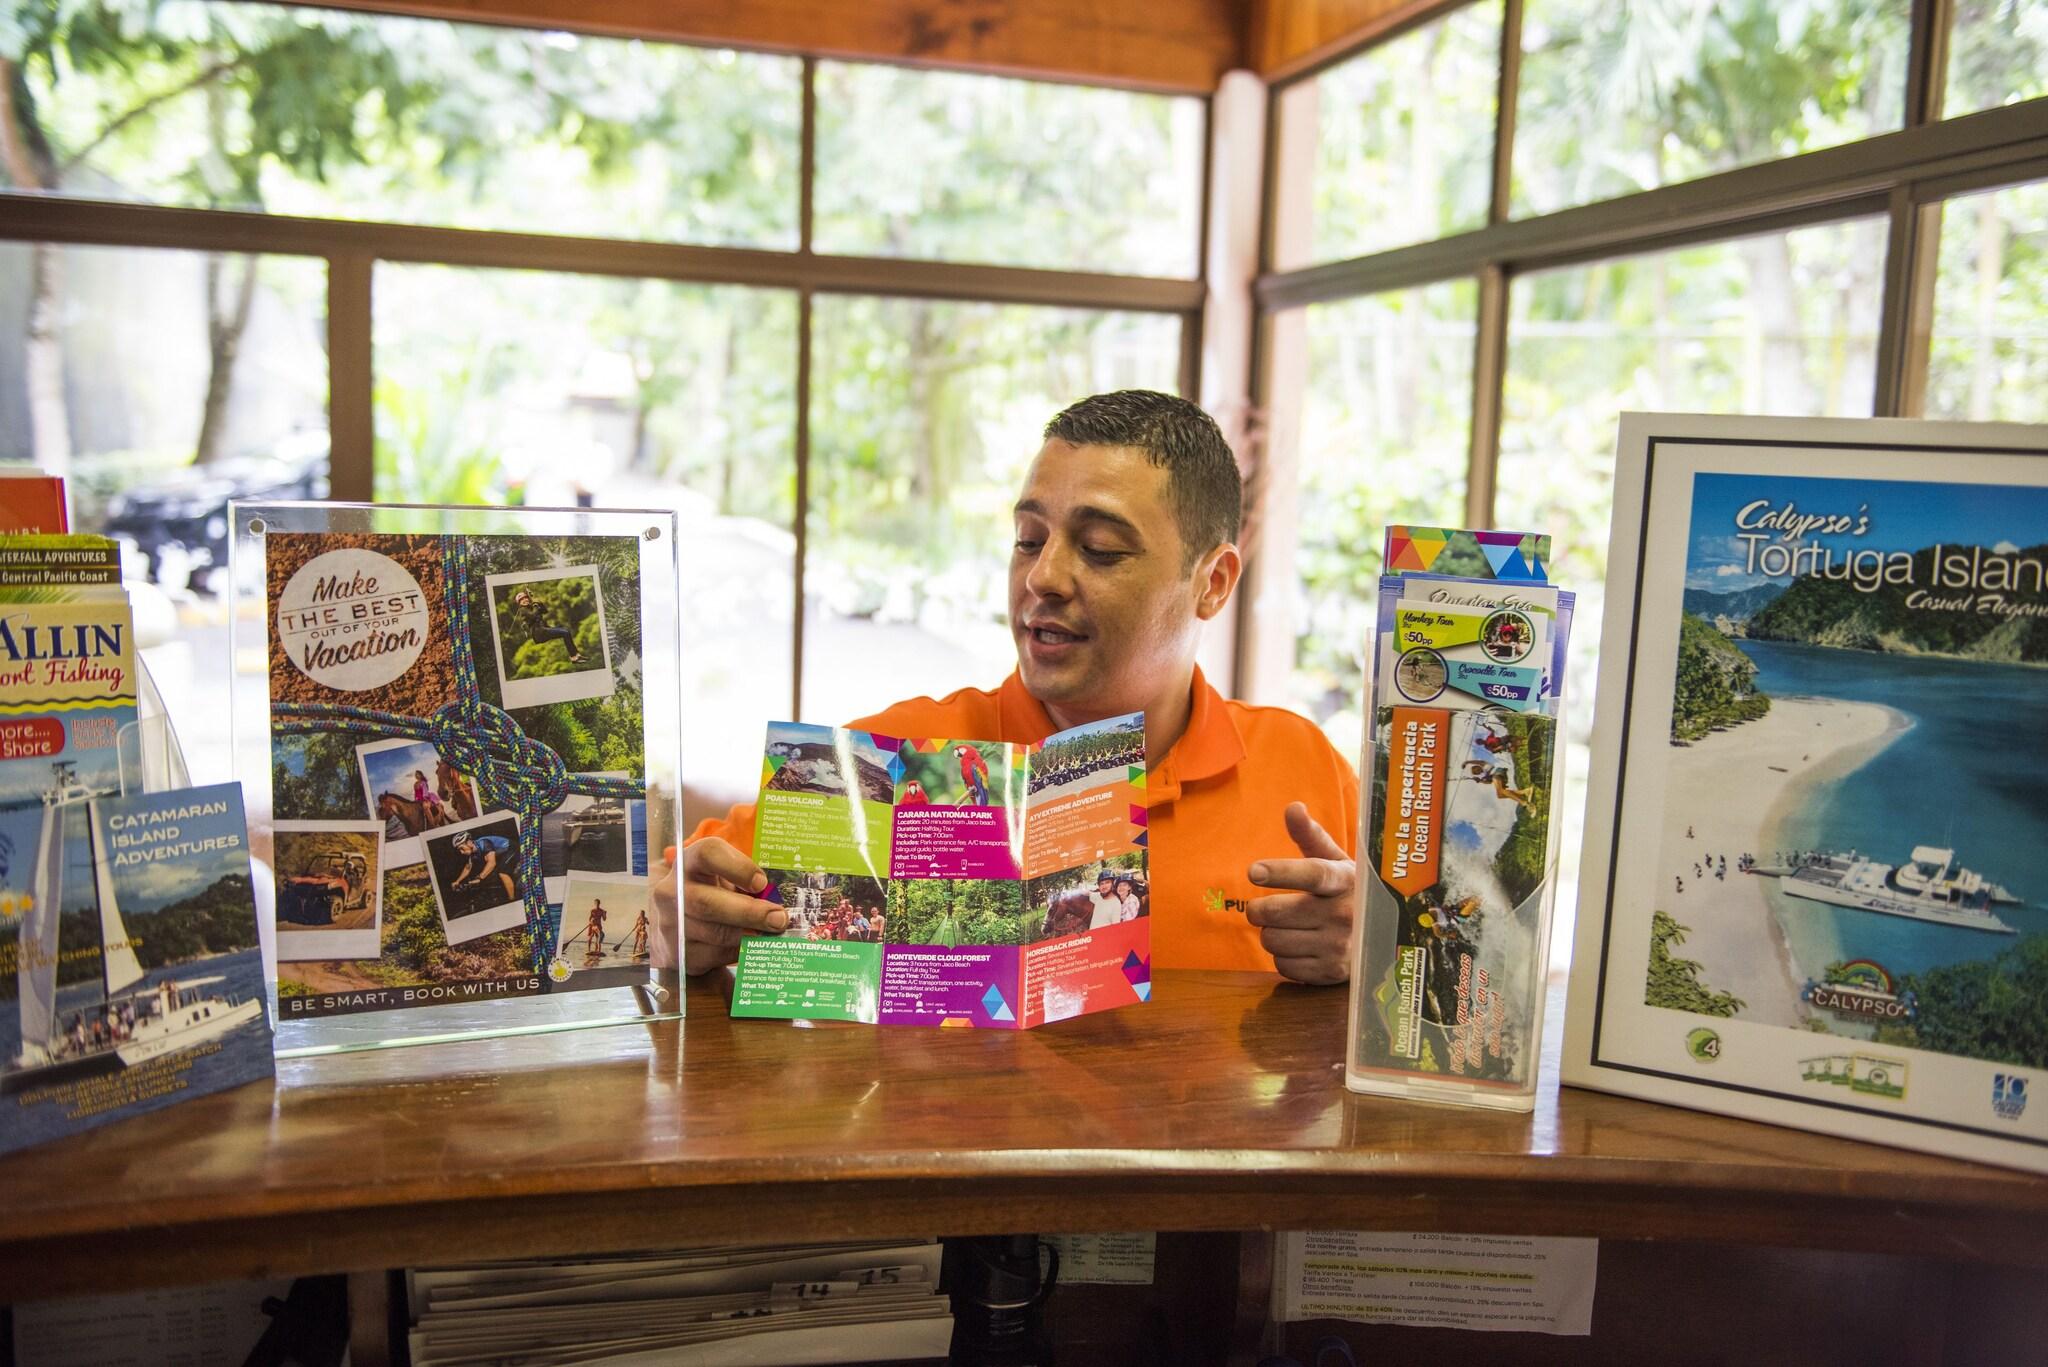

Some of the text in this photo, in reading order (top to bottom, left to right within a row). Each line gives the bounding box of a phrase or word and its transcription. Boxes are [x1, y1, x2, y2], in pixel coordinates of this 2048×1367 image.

[1736, 500, 1870, 541] Calypso's
[0, 552, 107, 562] TERFALL ADVENTURES
[1736, 533, 2048, 593] Tortuga Islan
[2, 571, 108, 583] Central Pacific Coast
[312, 569, 379, 603] Make
[282, 594, 418, 630] THE BEST
[1905, 590, 1972, 613] Casual
[311, 618, 399, 639] OUT OF YOUR
[1403, 612, 1434, 626] Monkey
[1437, 616, 1454, 626] Tour
[304, 628, 420, 671] Vacation
[1404, 632, 1432, 645] $50pp
[43, 656, 124, 692] Fishing
[1459, 664, 1496, 676] Crocodile
[1498, 667, 1517, 677] Tour
[1488, 685, 1518, 699] $50pp
[3, 741, 51, 757] Shore
[765, 794, 824, 806] POAS VOLCANO
[1042, 802, 1072, 817] EXTREME
[1072, 791, 1113, 807] ADVENTURE
[1392, 721, 1418, 879] Vive la experiencia
[1410, 722, 1437, 864] Ocean Ranch Park
[109, 802, 227, 830] CATAMARAN
[112, 827, 180, 849] ISLAND
[114, 835, 240, 867] ADVENTURES
[1224, 900, 1248, 912] PU
[747, 941, 842, 951] NAUYACA WATERFALLS
[1026, 936, 1092, 958] HORSEBACK RIDING
[1454, 953, 1472, 999] deseas
[1478, 968, 1488, 986] un
[291, 978, 540, 1011] BE SMART, BOOK WITH US
[1395, 950, 1414, 1052] Ocean Ranch Park
[1476, 988, 1487, 1004] en
[1815, 987, 1904, 1016] CALYPSO
[1457, 999, 1469, 1024] que
[1704, 1039, 1719, 1058] 4
[862, 1268, 900, 1284] 15
[792, 1284, 831, 1298] 14
